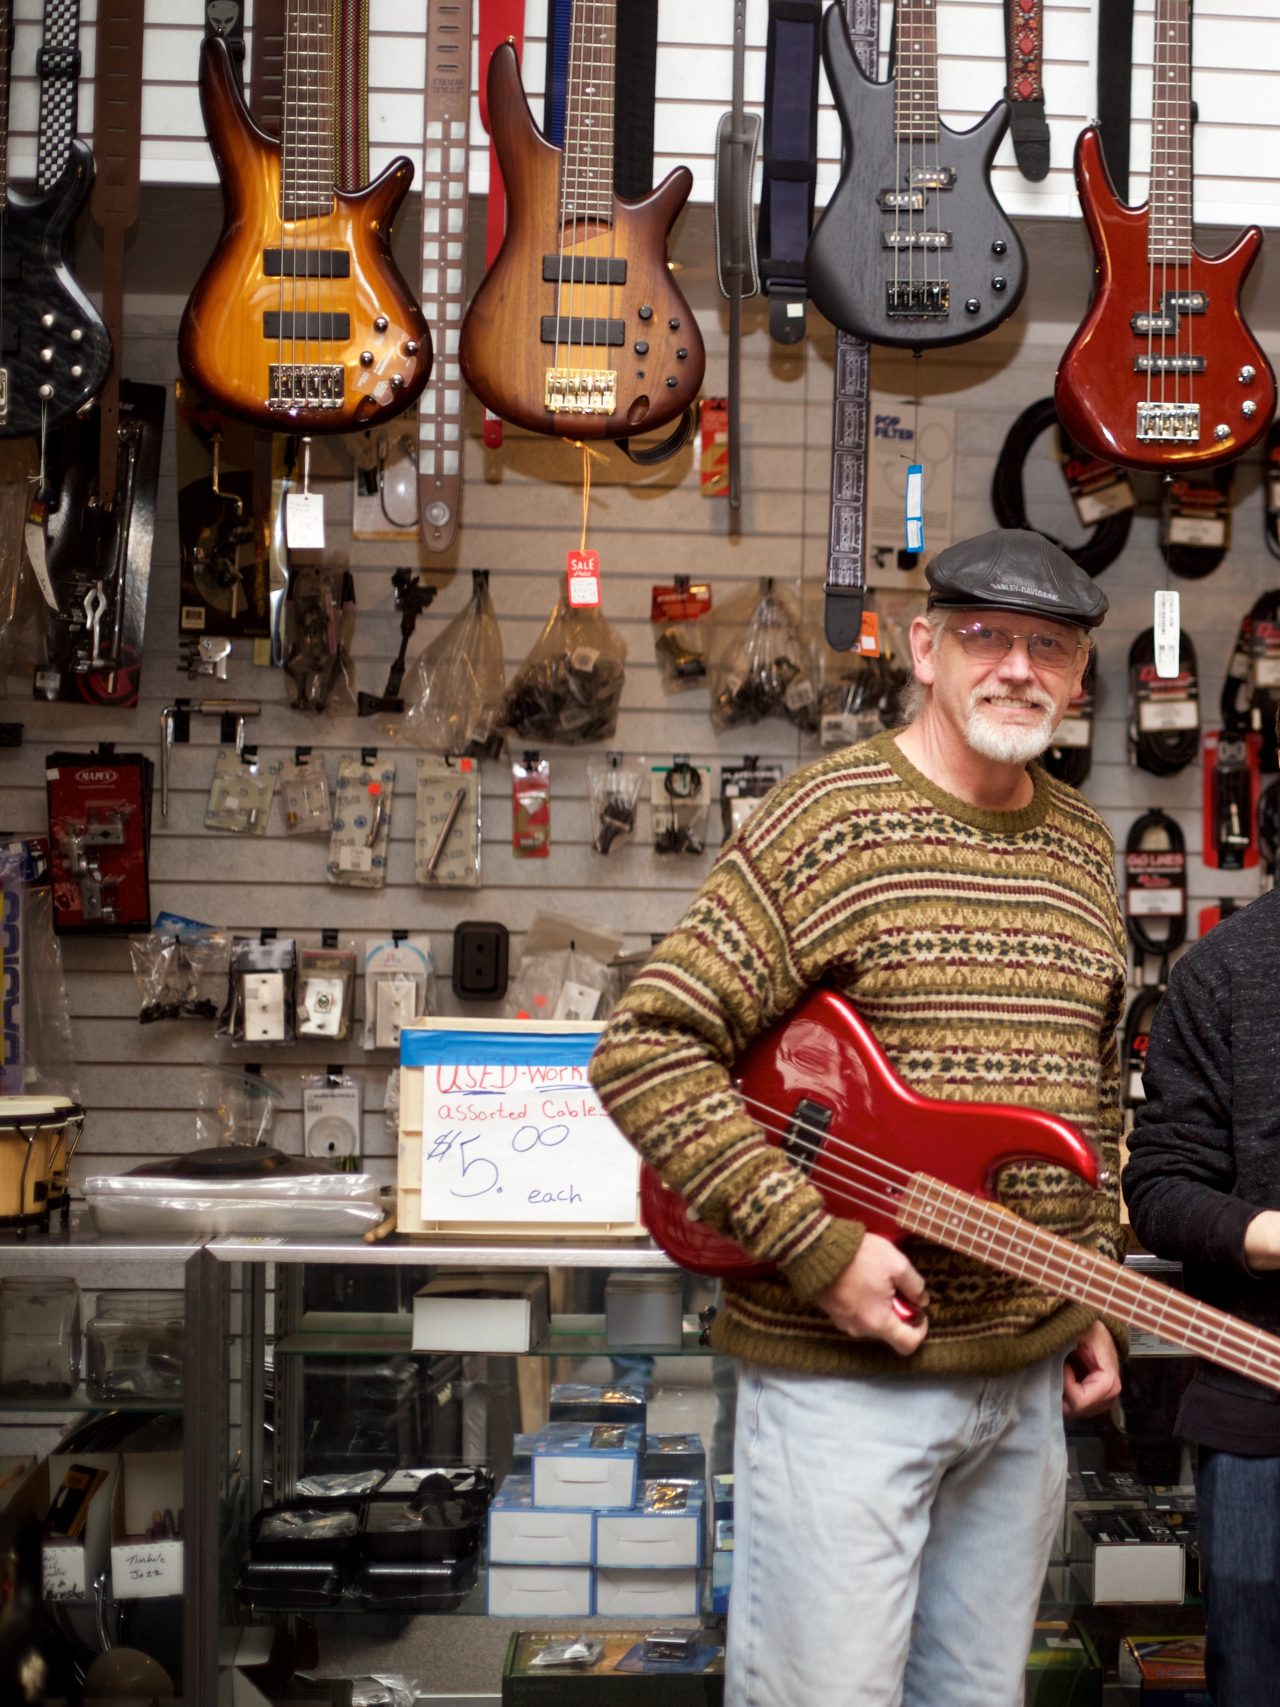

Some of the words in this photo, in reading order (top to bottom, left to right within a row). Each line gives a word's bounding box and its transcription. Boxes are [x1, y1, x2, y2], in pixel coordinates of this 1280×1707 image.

[874, 414, 901, 427] POP
[874, 426, 915, 440] FILTER
[571, 558, 595, 571] SALE
[82, 771, 110, 781] MAPEX
[438, 1104, 527, 1121] assorted
[528, 1184, 582, 1204] each
